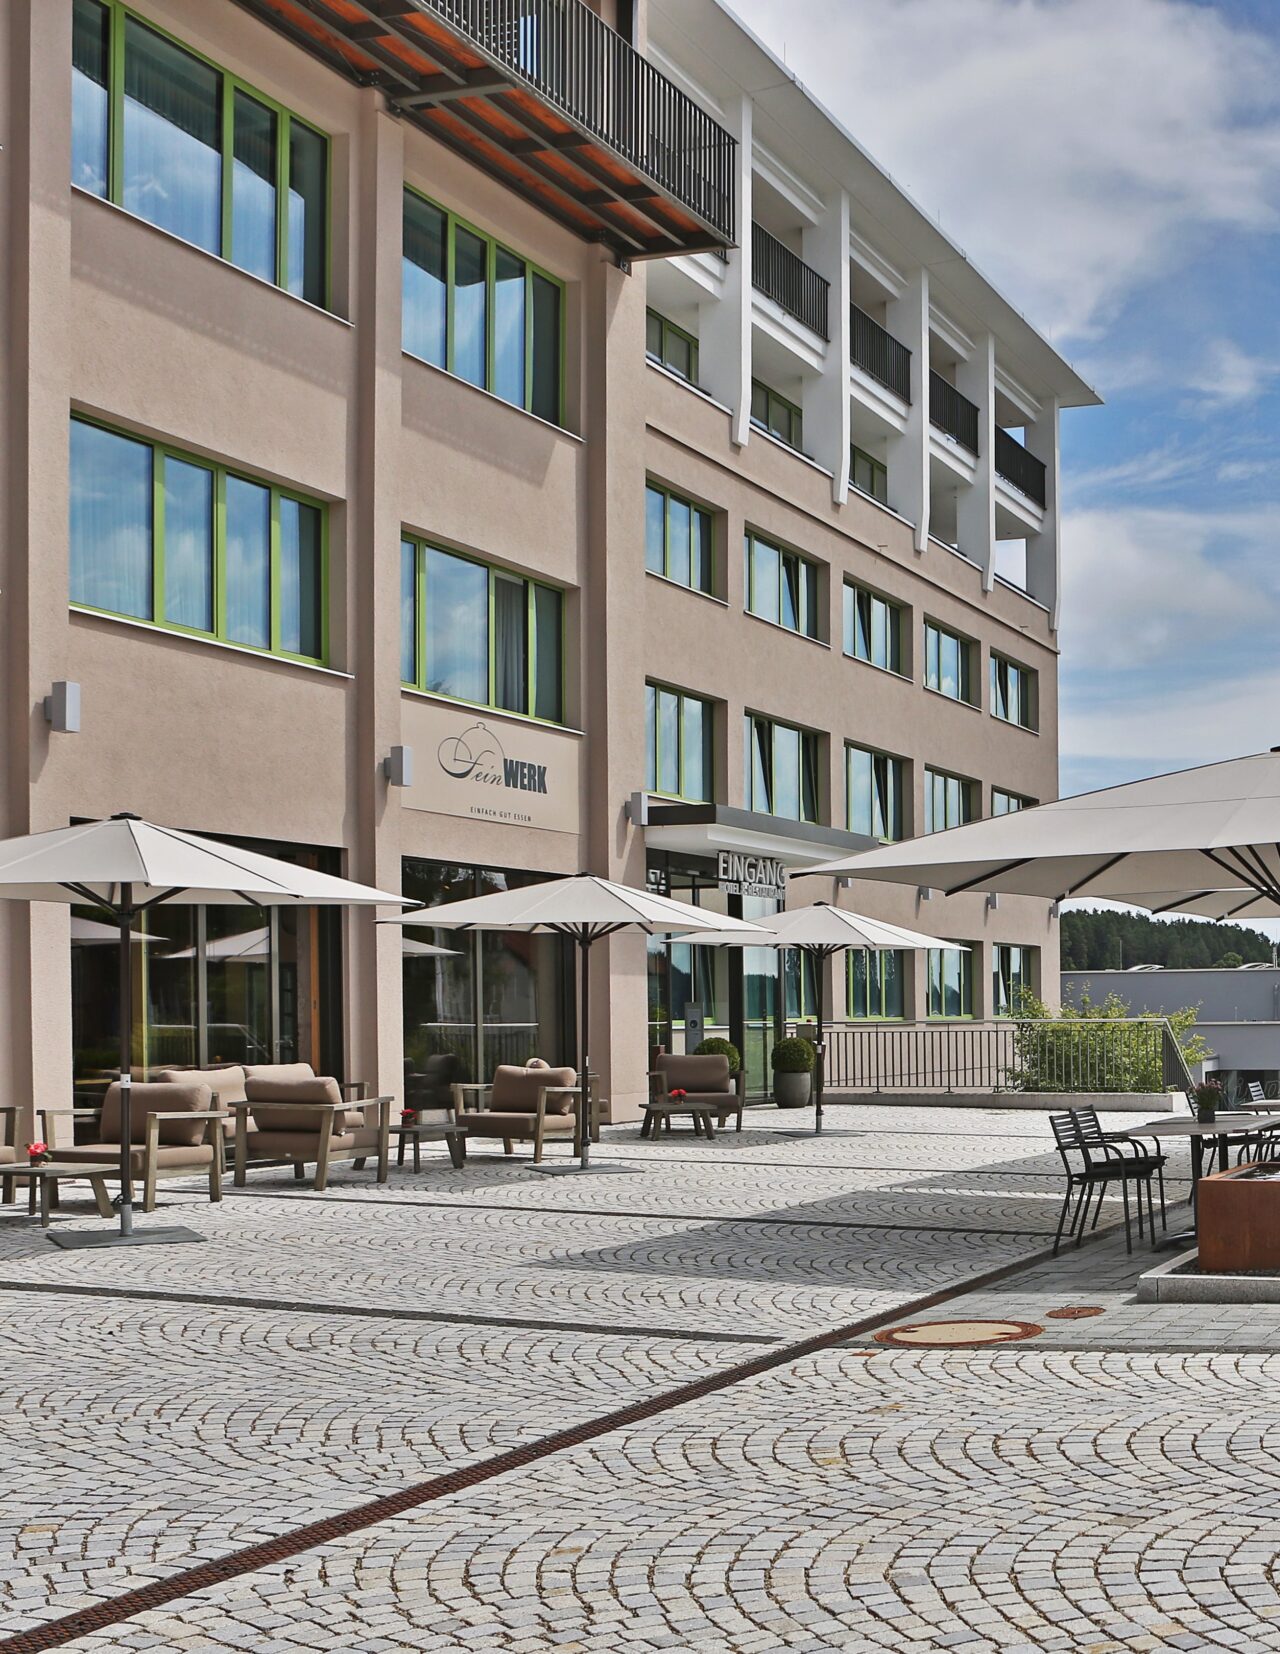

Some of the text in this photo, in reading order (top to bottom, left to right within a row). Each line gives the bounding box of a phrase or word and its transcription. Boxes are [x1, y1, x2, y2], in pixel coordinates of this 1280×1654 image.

[470, 806, 532, 822] EINFACH GUT ESSEN
[719, 851, 786, 886] EINGANG
